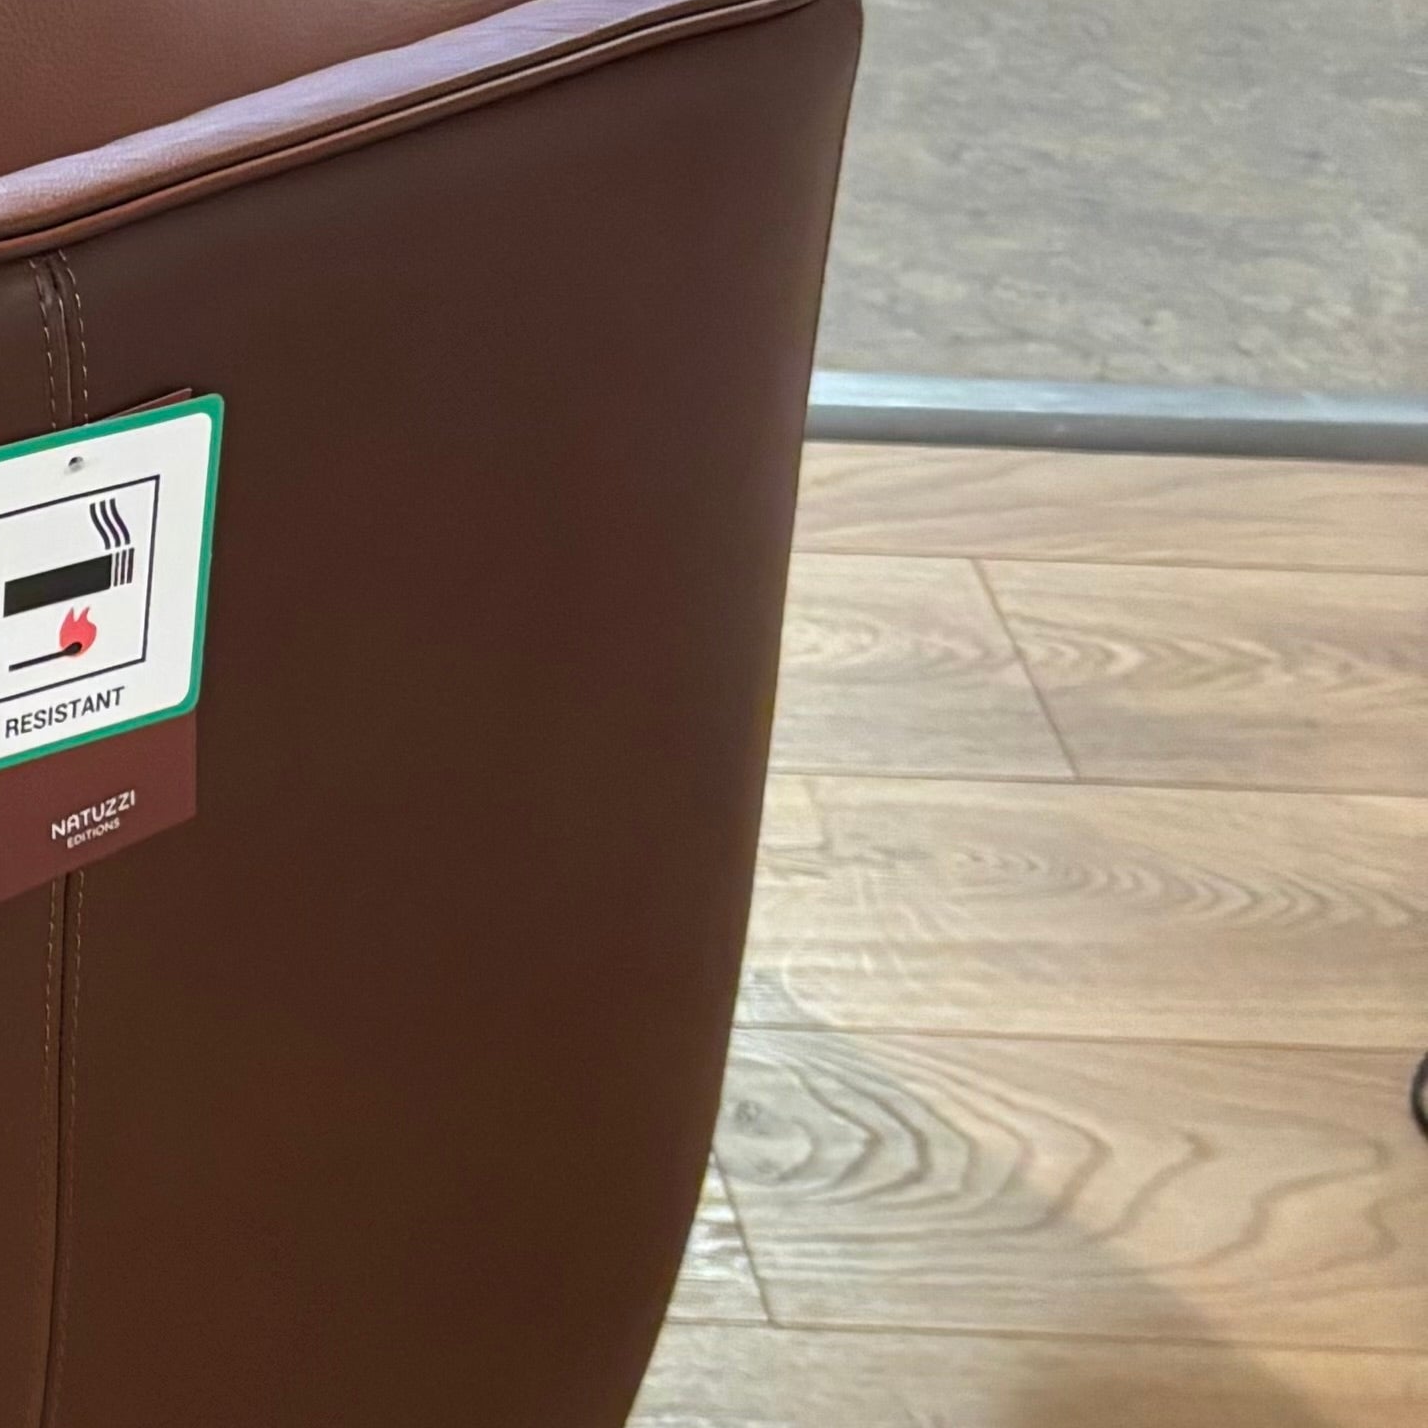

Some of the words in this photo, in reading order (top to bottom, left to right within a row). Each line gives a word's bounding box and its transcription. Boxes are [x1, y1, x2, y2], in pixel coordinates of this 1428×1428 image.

[5, 685, 126, 739] RESISTANT
[51, 789, 136, 840] NATUZZI
[66, 817, 121, 849] EDITIONS
